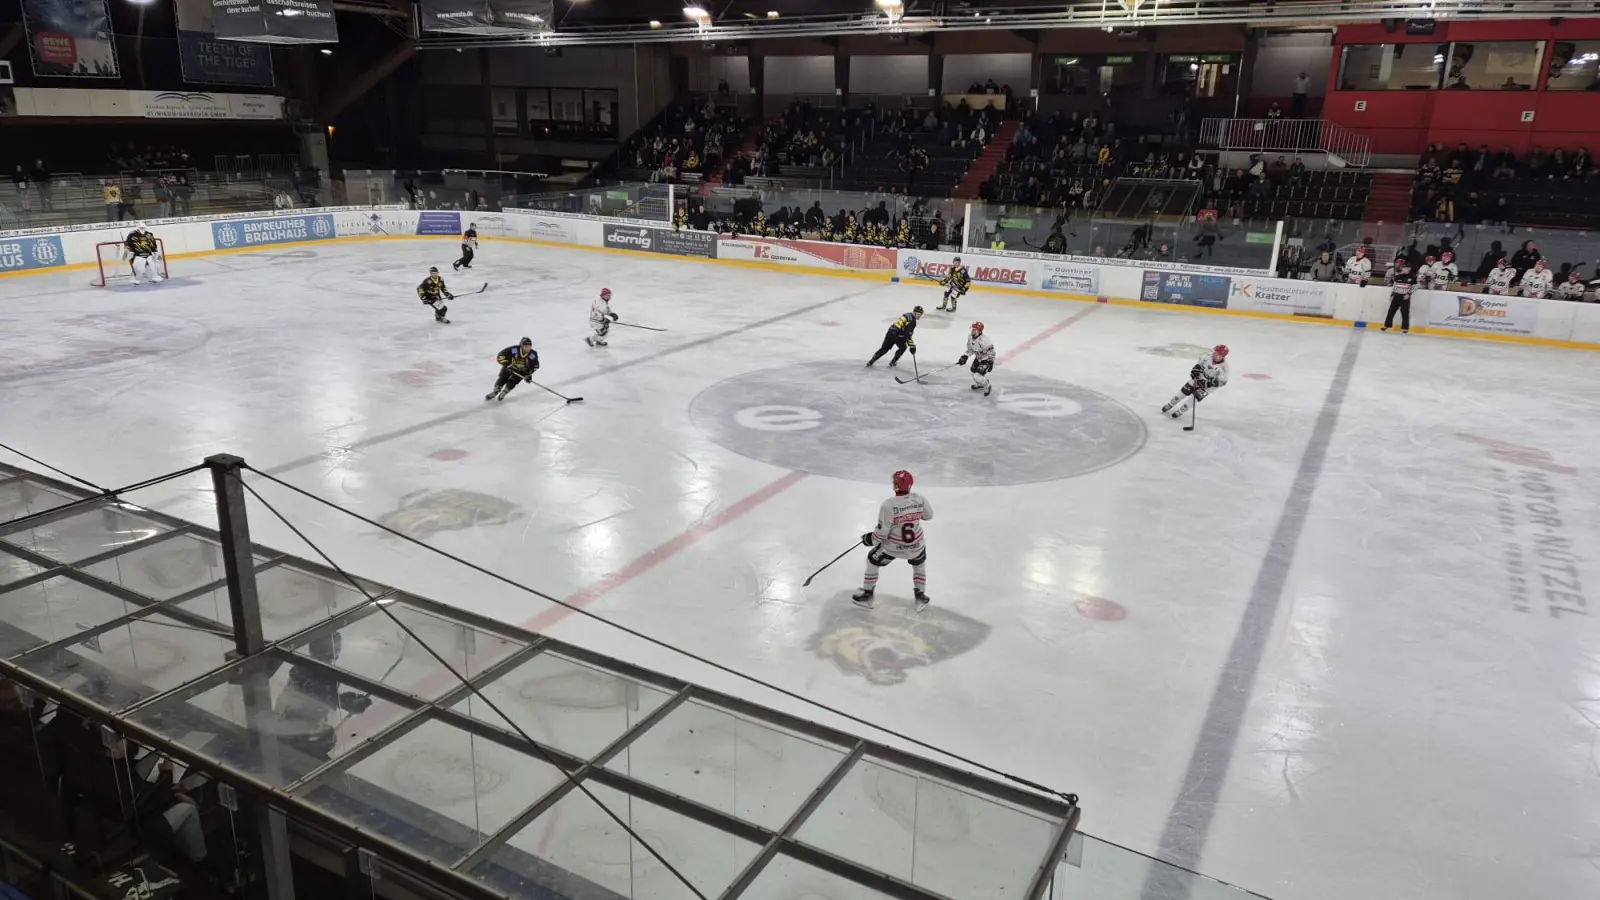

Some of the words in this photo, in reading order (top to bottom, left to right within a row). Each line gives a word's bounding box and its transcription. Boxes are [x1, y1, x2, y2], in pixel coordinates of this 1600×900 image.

[197, 41, 234, 55] TEETH
[238, 45, 253, 57] OF
[196, 54, 221, 67] THE
[224, 56, 256, 69] TIGER
[243, 219, 306, 233] BAYREUTHER
[244, 228, 308, 243] BRAUHAUS
[607, 231, 652, 249] dornig
[1254, 291, 1291, 302] Kratzer
[901, 522, 915, 544] 6
